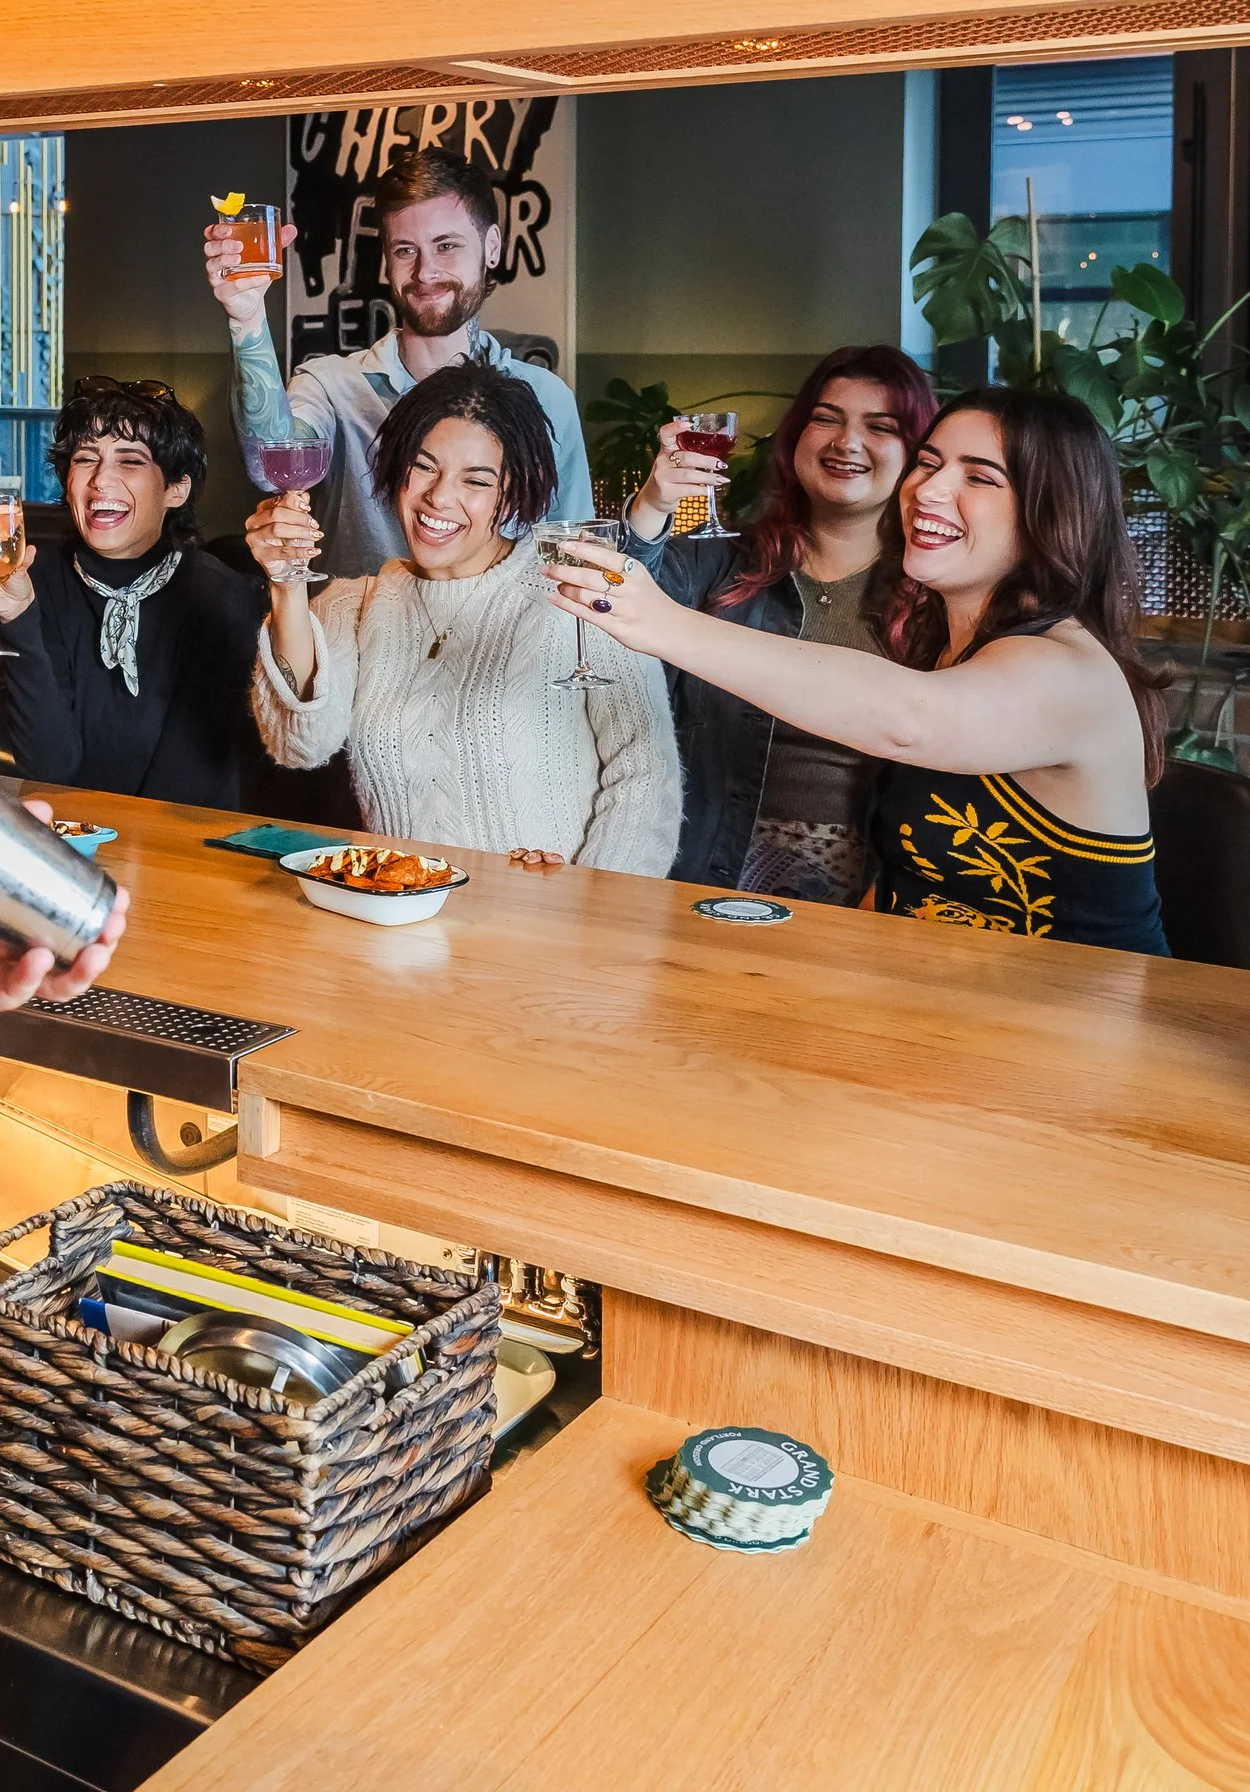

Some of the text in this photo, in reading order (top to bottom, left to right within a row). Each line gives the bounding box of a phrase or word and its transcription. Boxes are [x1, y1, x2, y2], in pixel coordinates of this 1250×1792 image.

[699, 1431, 742, 1446] PORTLAND
[727, 1441, 820, 1500] GRAND STARK
